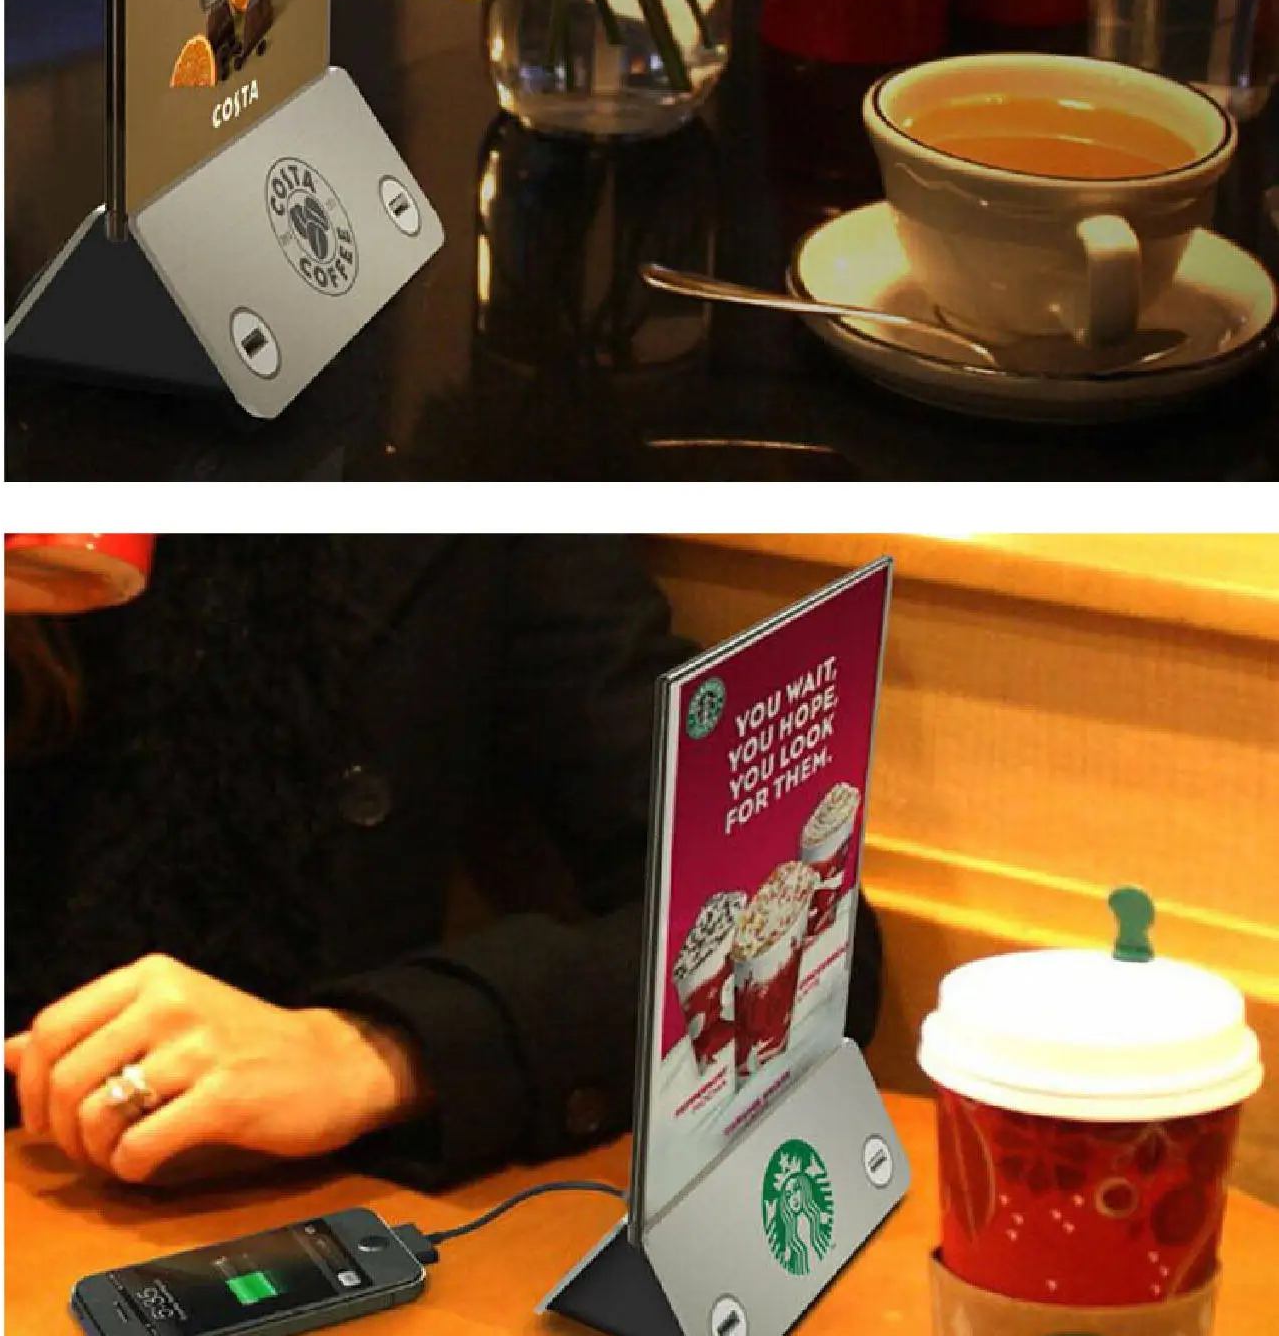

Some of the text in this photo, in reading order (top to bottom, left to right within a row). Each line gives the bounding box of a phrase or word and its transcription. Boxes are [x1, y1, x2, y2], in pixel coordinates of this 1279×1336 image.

[212, 79, 259, 129] COSTA
[271, 164, 316, 216] COSTA
[300, 226, 353, 288] COFFEE
[728, 724, 774, 772] YOU
[779, 684, 839, 741] HOPE,
[734, 690, 781, 738] YOU
[786, 656, 838, 703] WAIT,
[725, 746, 833, 835] FOR THEM.
[729, 713, 835, 800] YOU LOOK
